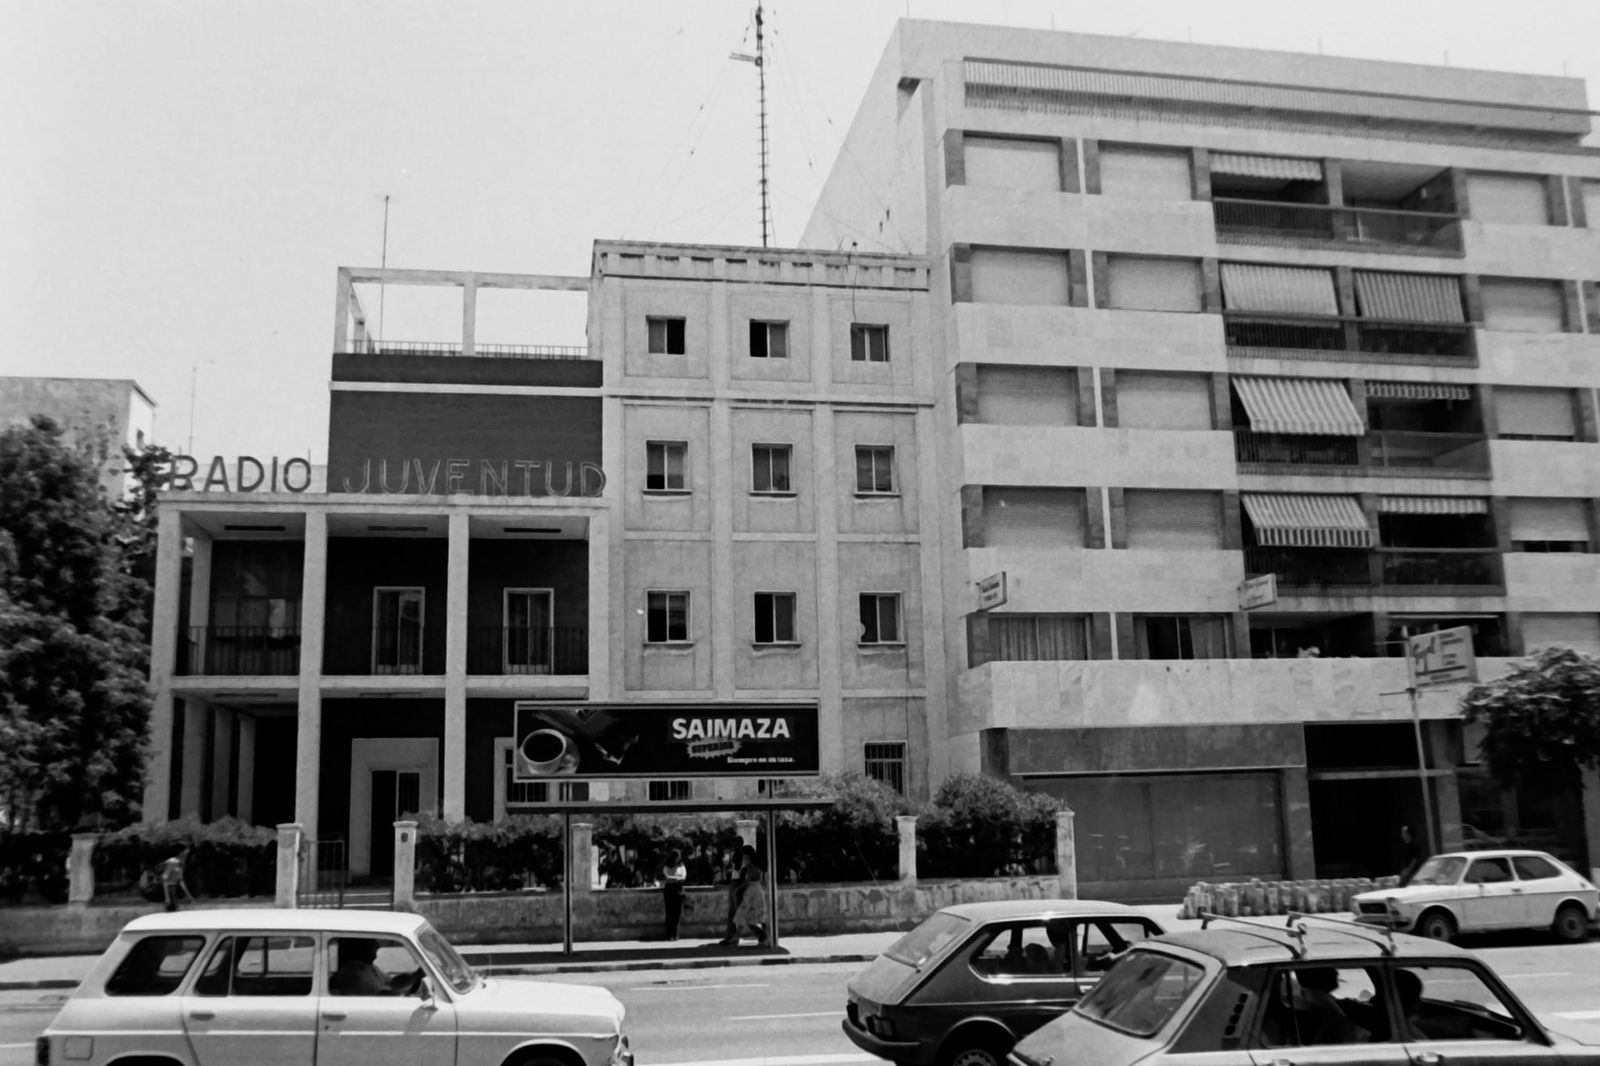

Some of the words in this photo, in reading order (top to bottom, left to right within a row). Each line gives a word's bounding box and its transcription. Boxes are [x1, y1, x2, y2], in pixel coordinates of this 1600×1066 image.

[168, 455, 312, 493] RADIO
[342, 458, 607, 498] JUVENTUD
[672, 717, 791, 739] SAIMAZA
